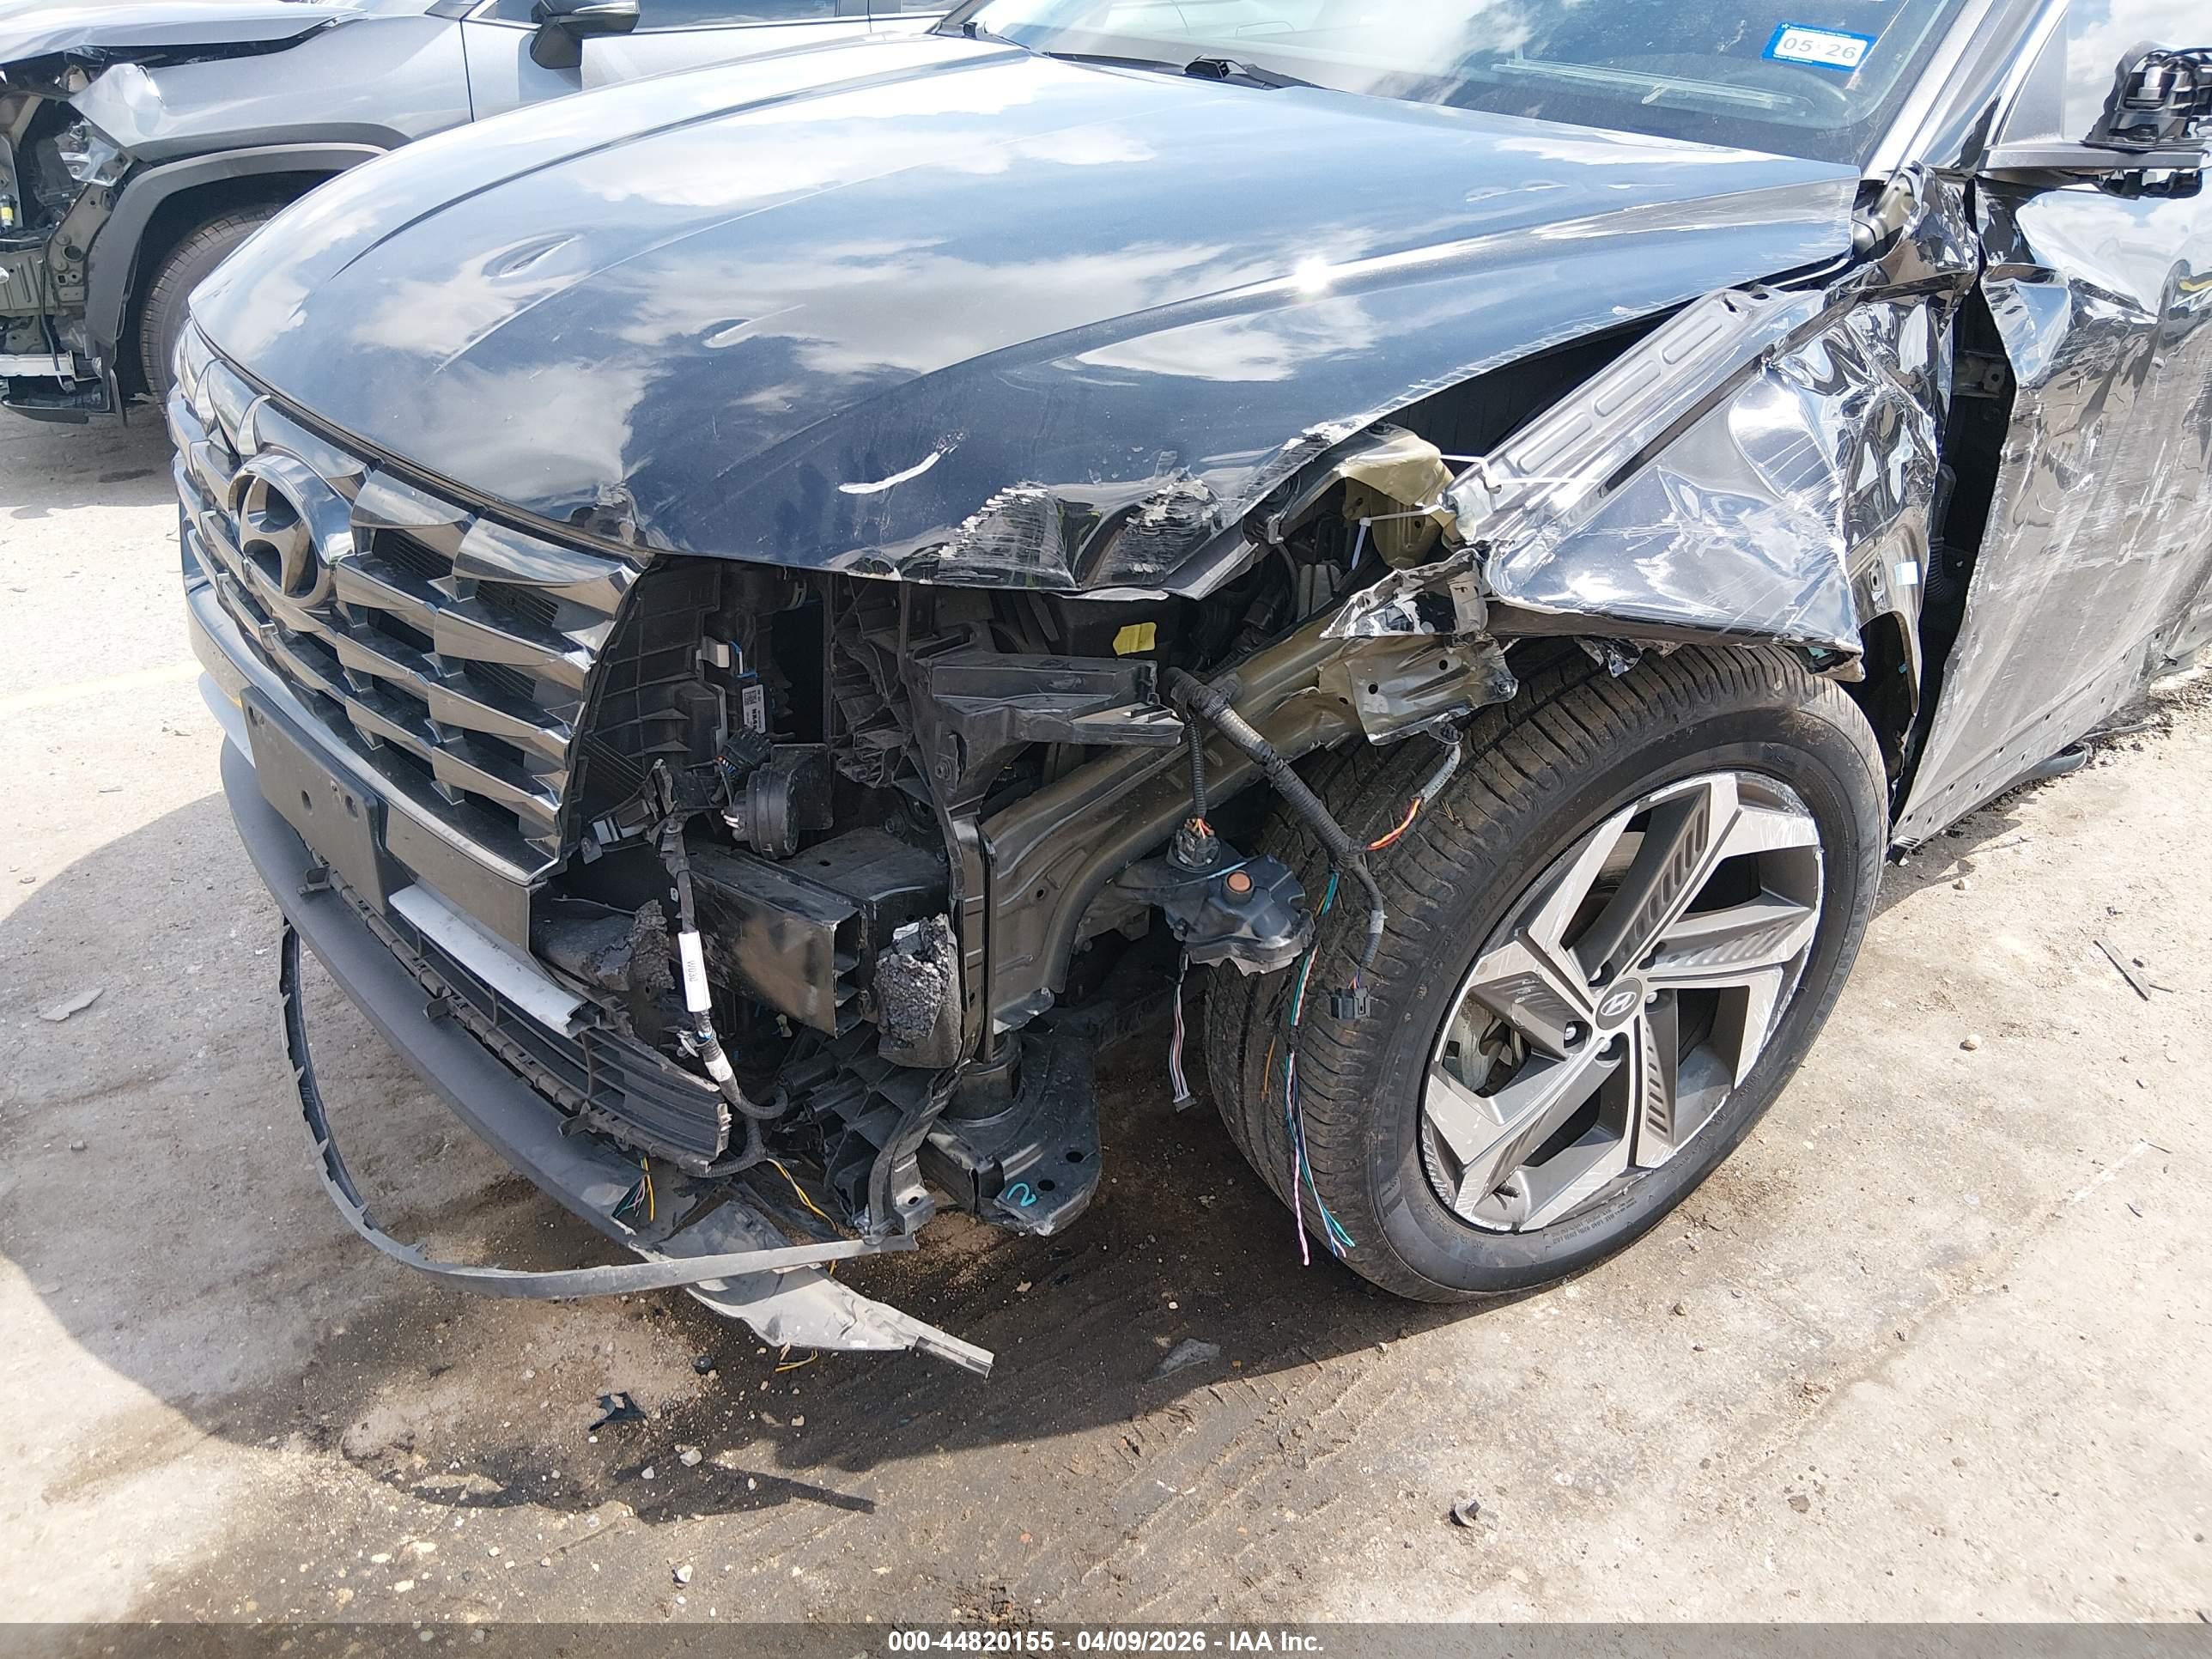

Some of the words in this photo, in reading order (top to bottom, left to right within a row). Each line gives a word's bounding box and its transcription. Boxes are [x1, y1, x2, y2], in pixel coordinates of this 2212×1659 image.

[1783, 37, 1814, 52] 05
[1825, 43, 1856, 58] 26
[1006, 1182, 1037, 1206] 2
